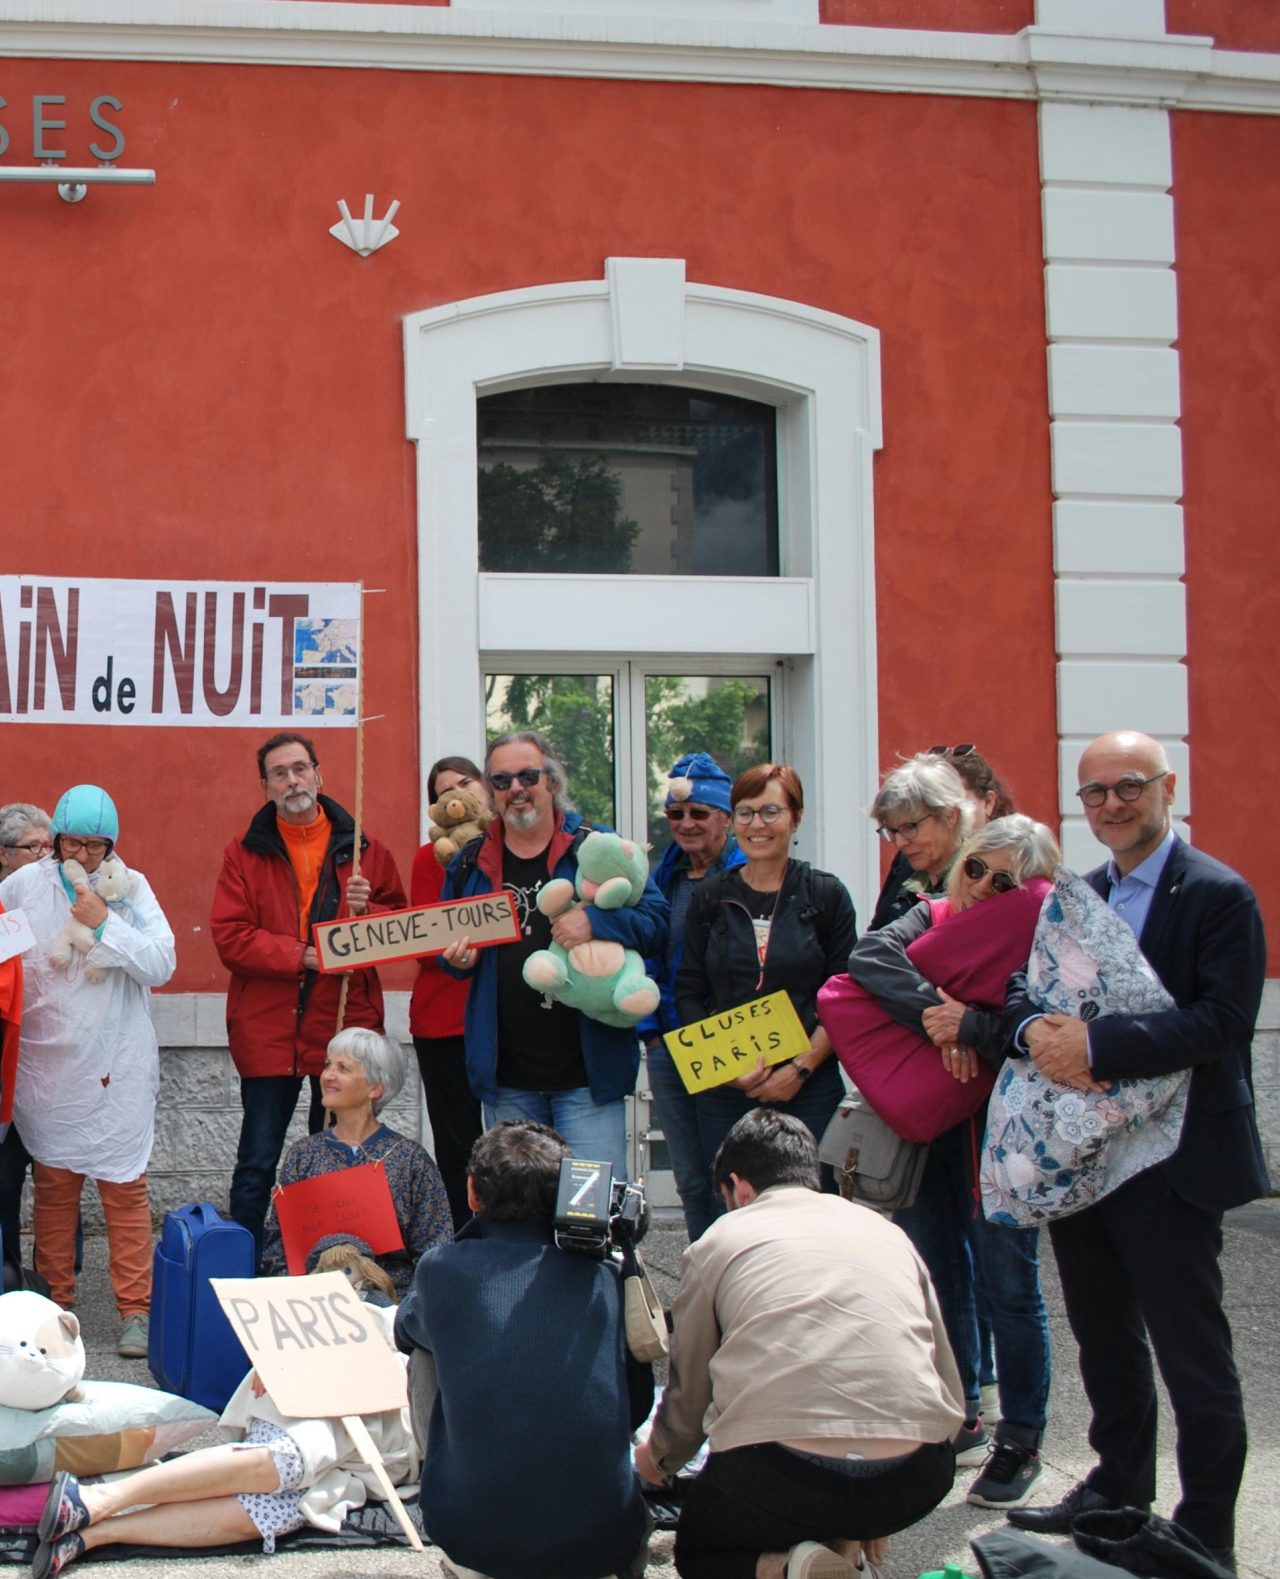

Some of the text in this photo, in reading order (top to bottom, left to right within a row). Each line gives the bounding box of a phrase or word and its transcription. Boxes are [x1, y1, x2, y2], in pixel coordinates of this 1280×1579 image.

[92, 655, 136, 714] de
[327, 912, 428, 957] GENEVE
[442, 901, 512, 931] TOURS
[678, 1000, 772, 1047] CLUSES
[229, 1291, 368, 1351] PARIS
